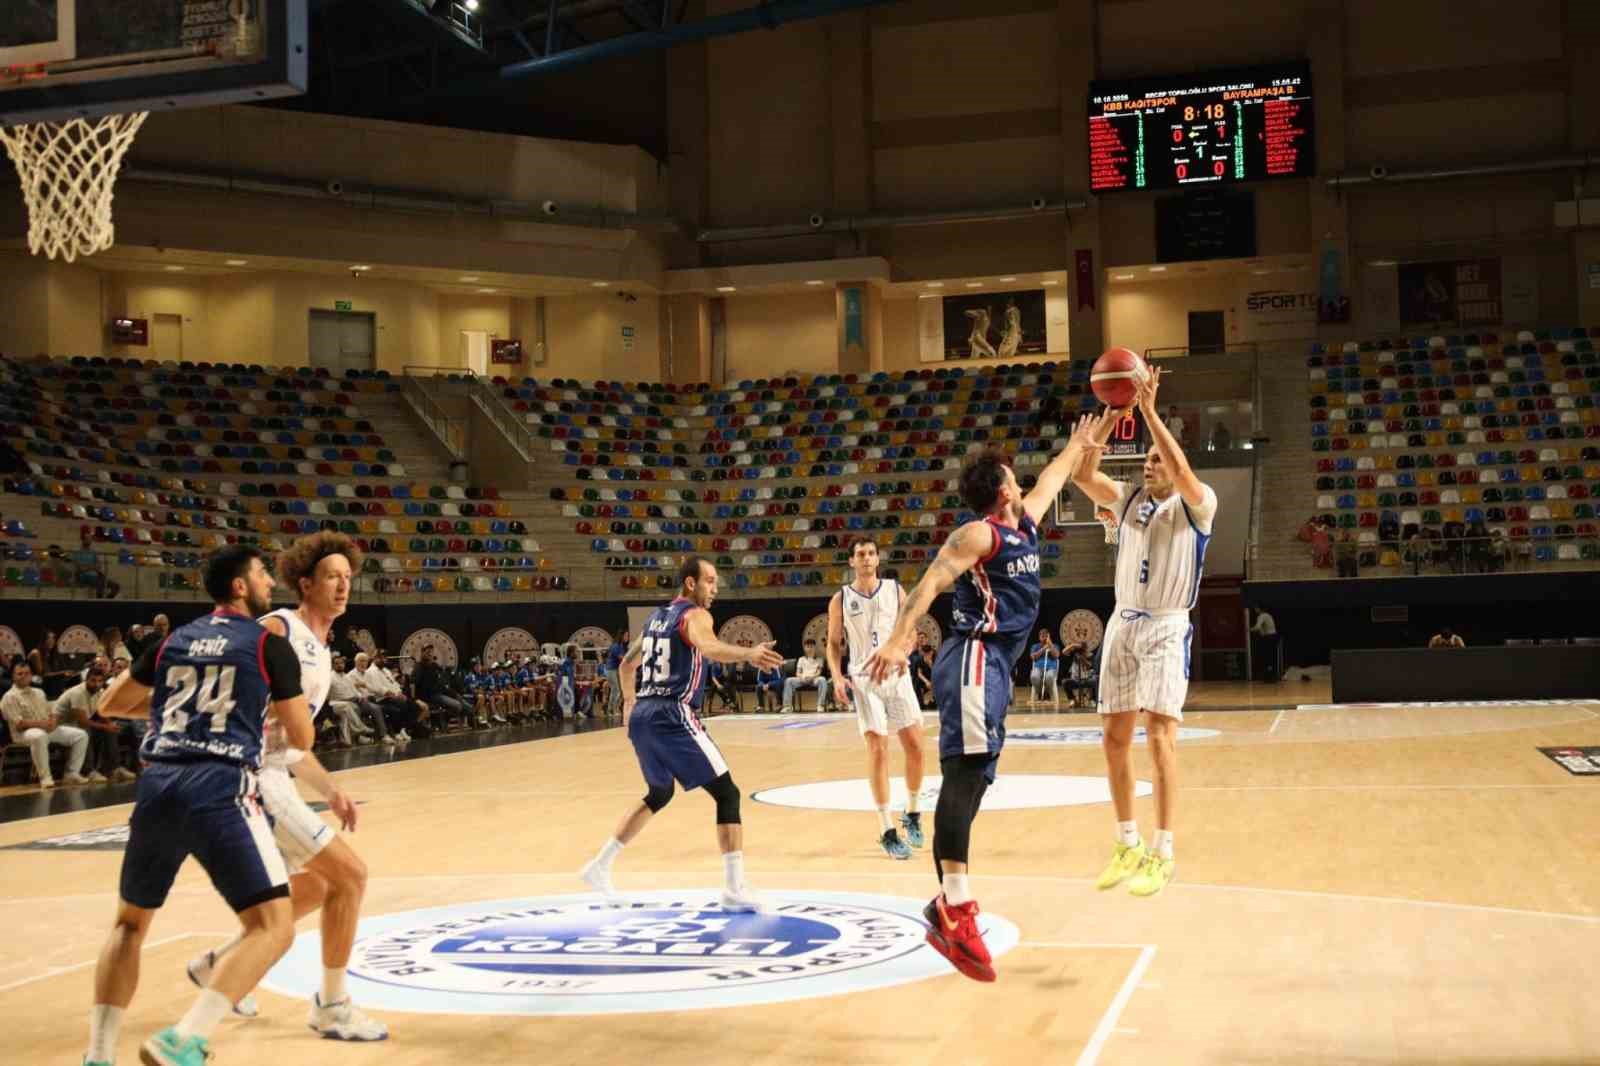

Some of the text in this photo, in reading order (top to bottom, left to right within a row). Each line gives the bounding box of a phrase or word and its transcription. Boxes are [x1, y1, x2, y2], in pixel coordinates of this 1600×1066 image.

[1173, 129, 1183, 143] 0
[1175, 164, 1187, 180] 0
[1213, 160, 1225, 176] 0
[187, 634, 230, 657] DENİZ
[871, 631, 879, 648] 3
[641, 636, 671, 682] 23
[160, 664, 237, 734] 24
